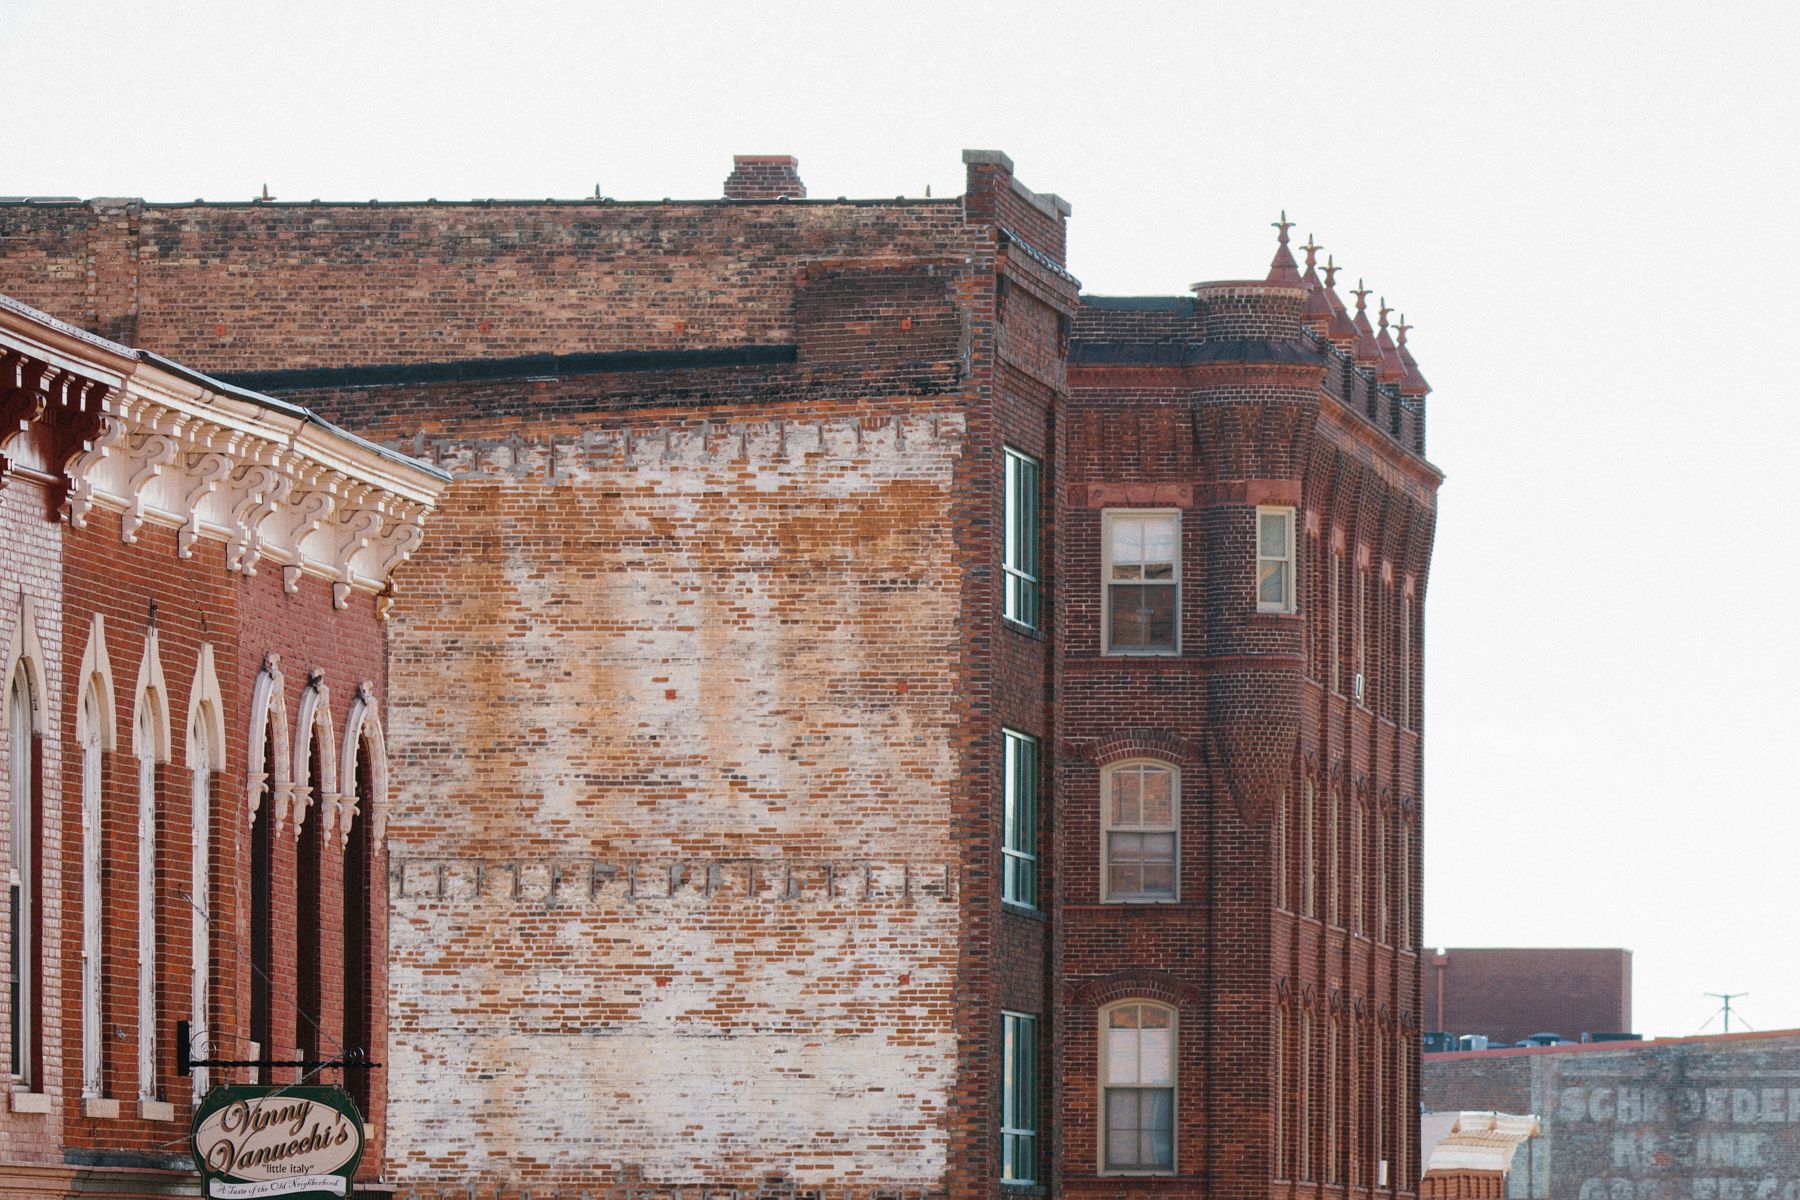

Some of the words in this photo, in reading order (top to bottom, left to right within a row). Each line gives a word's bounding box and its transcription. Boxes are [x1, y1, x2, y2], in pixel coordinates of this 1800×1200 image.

[220, 1100, 313, 1136] Vinny
[205, 1112, 348, 1176] Vanucchi's
[227, 1185, 247, 1195] Taste
[248, 1185, 257, 1195] of
[258, 1184, 268, 1193] the
[270, 1181, 286, 1191] Old
